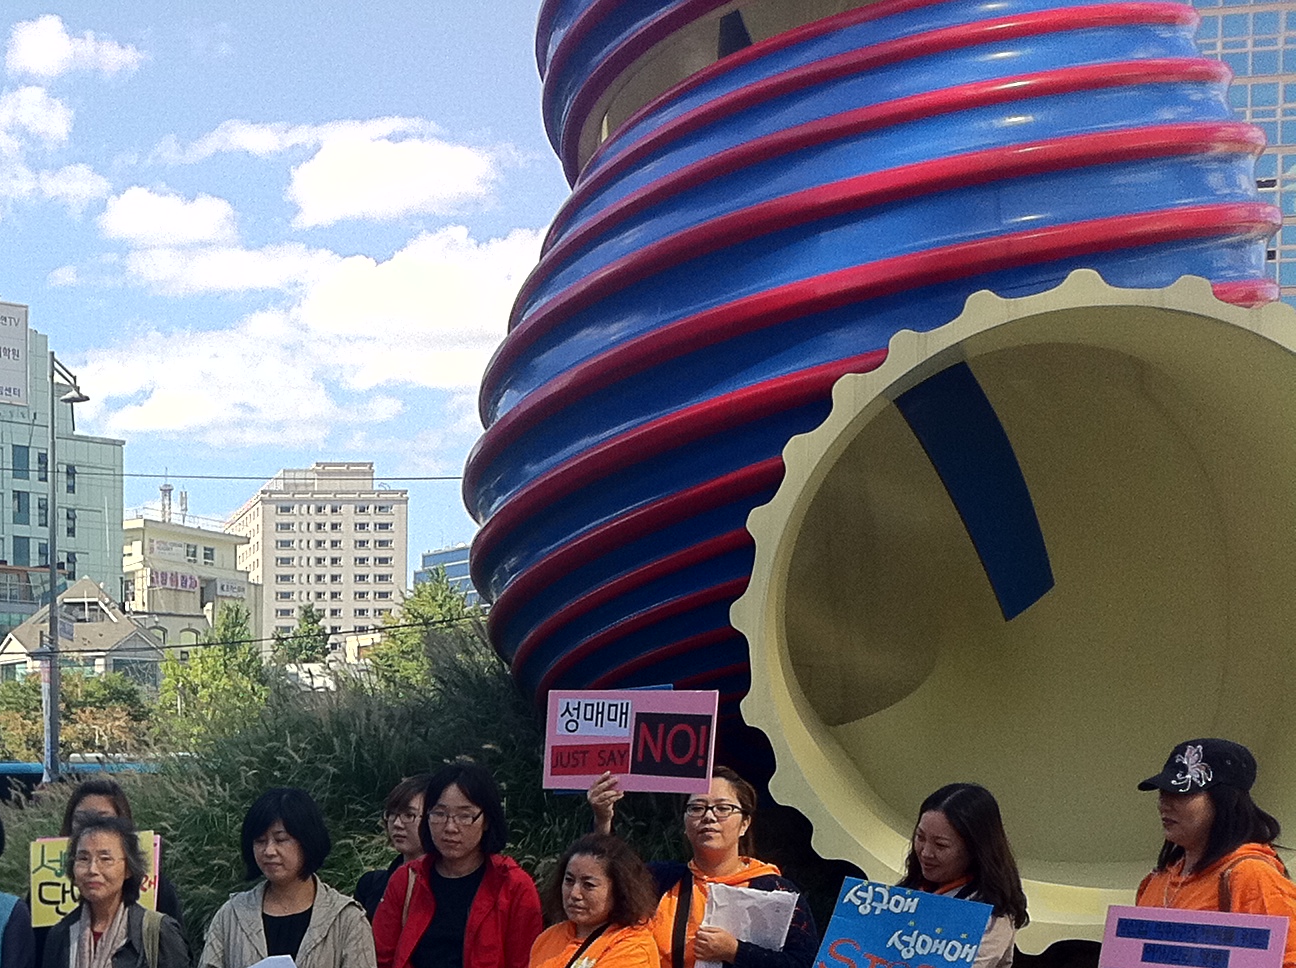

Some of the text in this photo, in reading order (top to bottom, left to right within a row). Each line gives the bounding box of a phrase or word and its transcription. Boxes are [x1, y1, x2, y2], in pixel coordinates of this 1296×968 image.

[559, 700, 630, 734] 성매매
[551, 749, 628, 769] JUST SAY
[636, 722, 708, 768] NO!
[843, 884, 919, 915] 성구매
[886, 930, 979, 963] 성매매
